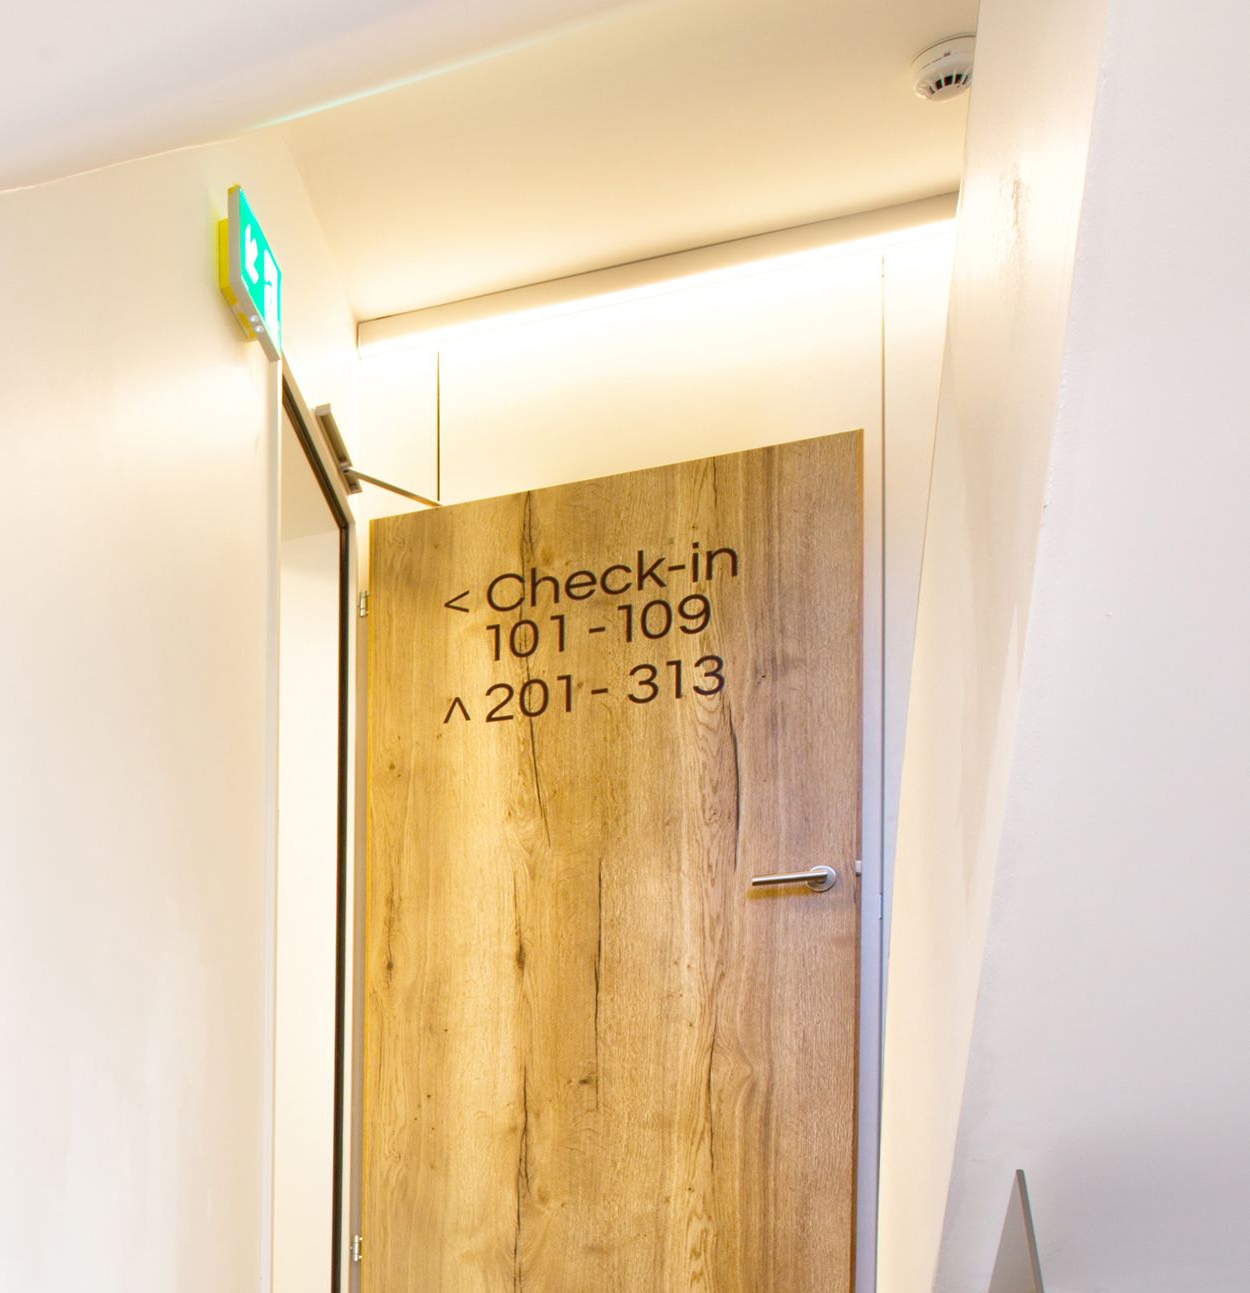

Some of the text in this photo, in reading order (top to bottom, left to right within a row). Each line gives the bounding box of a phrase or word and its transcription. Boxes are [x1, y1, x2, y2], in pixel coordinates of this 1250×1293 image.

[486, 542, 738, 612] Check-in
[486, 614, 567, 661] 101
[485, 674, 572, 723] 201
[627, 655, 725, 704] 313
